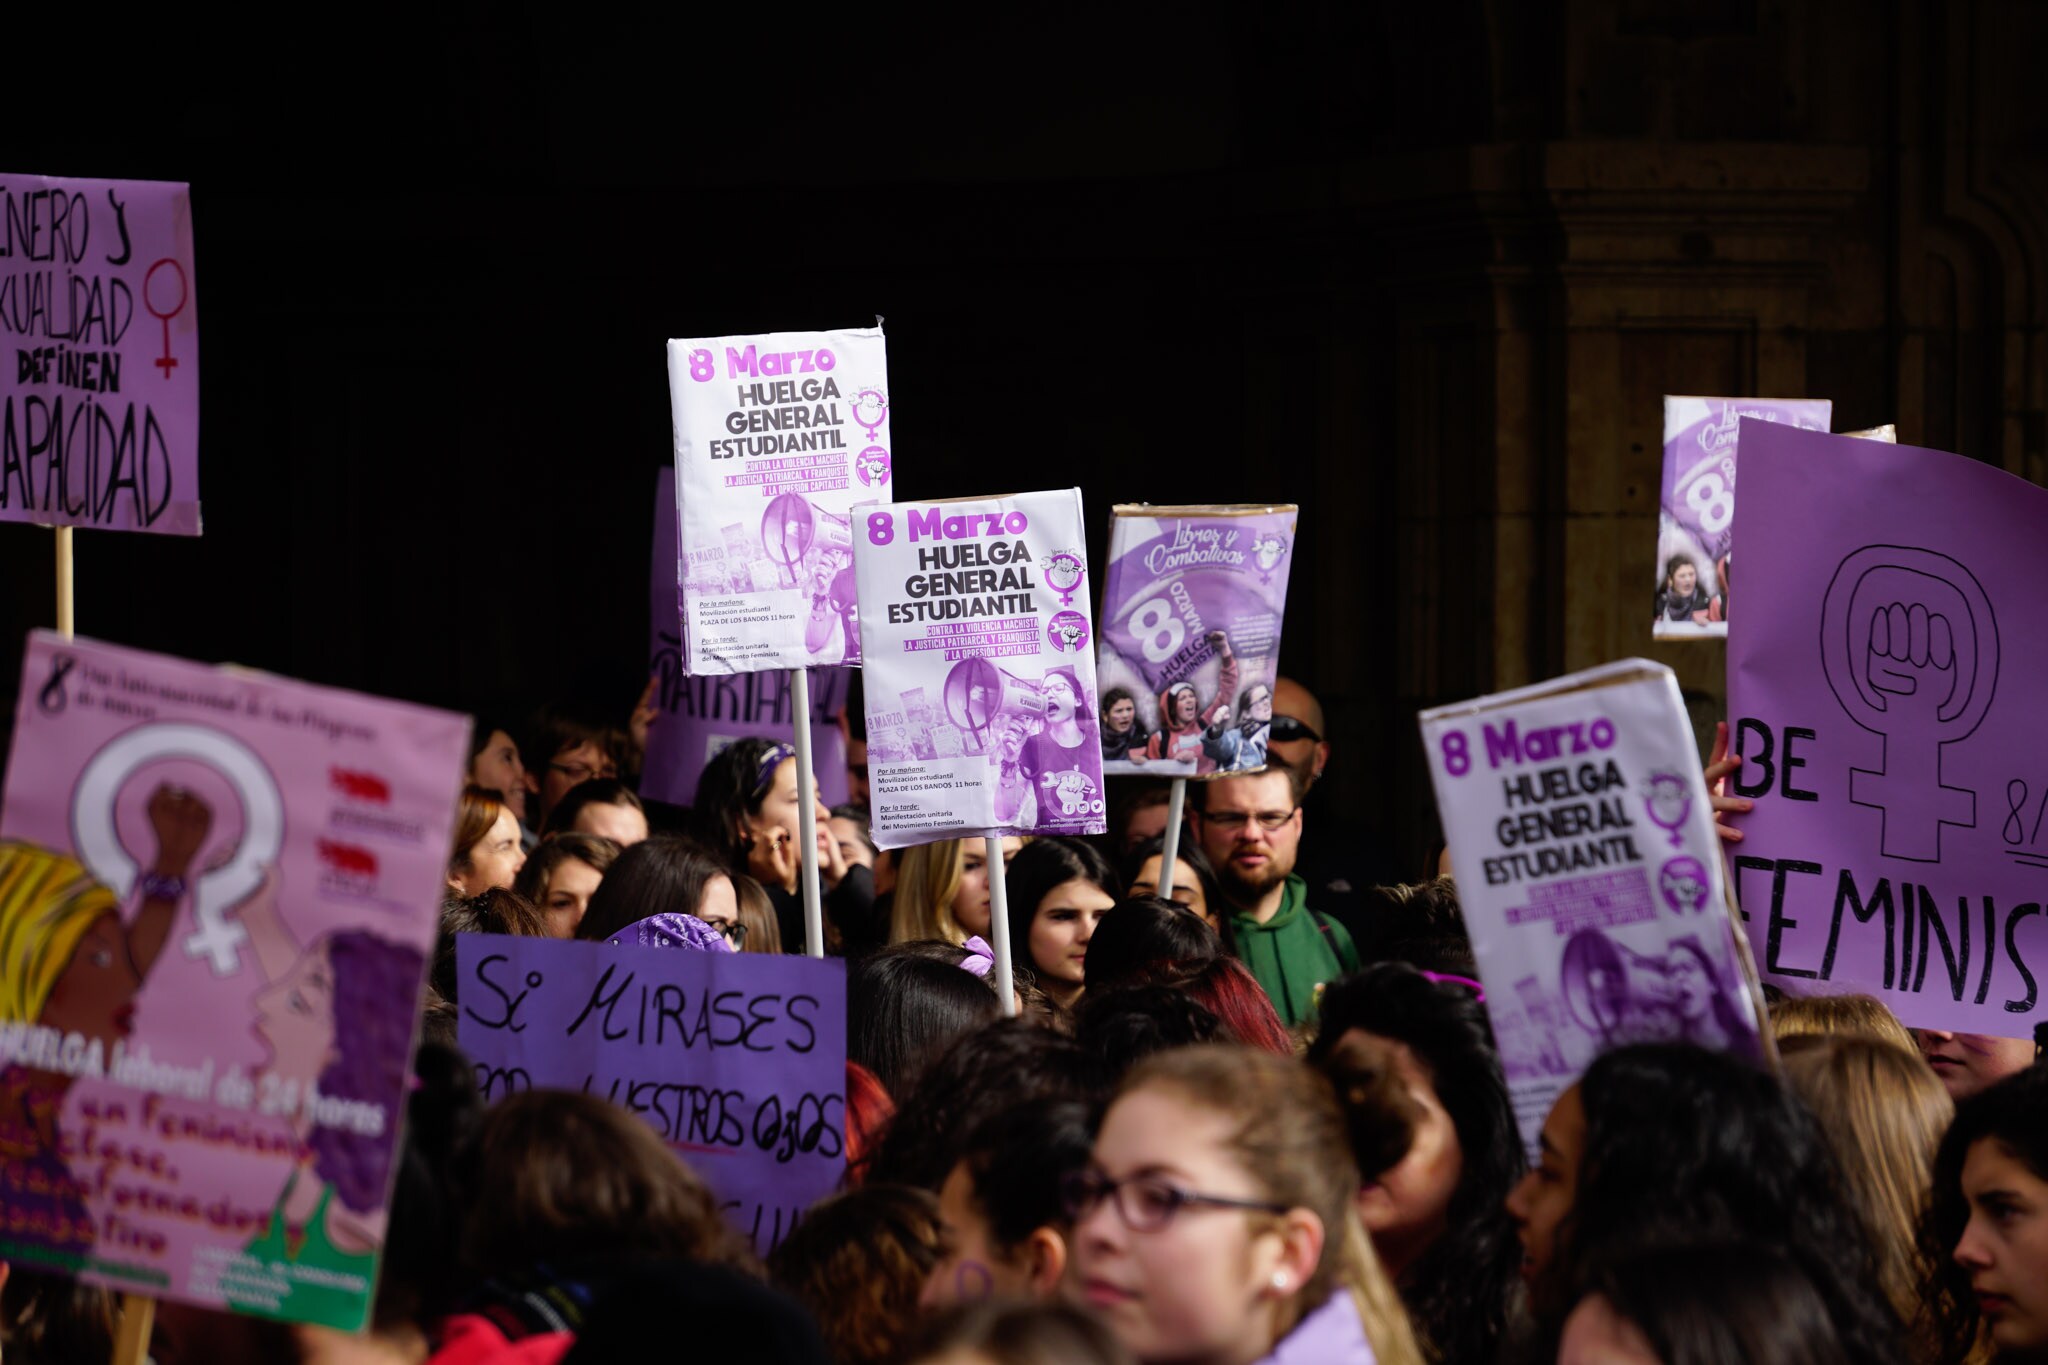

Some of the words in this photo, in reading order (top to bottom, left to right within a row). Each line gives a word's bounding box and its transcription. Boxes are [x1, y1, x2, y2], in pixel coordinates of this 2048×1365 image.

[688, 348, 715, 382] 8
[725, 344, 836, 379] Marzo
[737, 377, 841, 407] HUELGA
[725, 403, 844, 434] GENERAL
[709, 429, 847, 460] ESTUDIANTIL
[725, 475, 733, 487] LA
[735, 472, 763, 486] JUSTICIA
[765, 469, 802, 484] PATRIARCAL
[810, 465, 848, 480] FRANQUISTA
[746, 458, 770, 473] CONTRA
[771, 458, 781, 470] LA
[782, 455, 814, 469] VIOLENCIA
[815, 453, 847, 466] MACHISTA
[769, 484, 779, 495] LA
[810, 478, 849, 492] CAPITALISTA
[1686, 472, 1735, 533] 8
[867, 511, 894, 546] 8
[907, 507, 1028, 542] Marzo
[1166, 519, 1222, 553] Libres
[1226, 529, 1240, 547] y
[918, 540, 1032, 571] HUELGA
[1144, 543, 1246, 575] Combativas
[905, 566, 1035, 599] GENERAL
[699, 608, 738, 617] Movilización
[739, 605, 771, 614] estudiantil
[700, 617, 719, 626] PLAZA
[720, 617, 729, 625] DE
[730, 616, 742, 624] LOS
[743, 614, 769, 623] BANDOS
[779, 613, 795, 621] horas
[887, 593, 1037, 624] ESTUDIANTIL
[1170, 581, 1205, 635] MARZO
[904, 640, 913, 651] LA
[914, 638, 946, 650] JUSTICIA
[948, 634, 989, 648] PATRIARCAL
[998, 629, 1040, 644] FRANQUISTA
[927, 624, 953, 637] CONTRA
[955, 623, 965, 634] LA
[966, 620, 1002, 634] VIOLENCIA
[1004, 617, 1039, 630] MACHISTA
[1128, 598, 1185, 664] 8
[702, 644, 744, 653] Manifestación
[745, 642, 769, 650] unitaria
[702, 654, 711, 662] del
[751, 650, 779, 659] Feminista
[952, 649, 962, 660] LA
[963, 645, 996, 660] OPRESIÓN
[997, 643, 1040, 656] CAPITALISTA
[868, 718, 874, 730] 8
[874, 711, 904, 728] MARZO
[1441, 730, 1471, 777] 8
[1481, 718, 1616, 768] Marzo
[1733, 717, 1818, 801] BE
[878, 774, 918, 784] Movilización
[919, 772, 954, 781] estudiantil
[897, 765, 926, 774] mañana:
[1501, 758, 1626, 808] HUELGA
[878, 784, 899, 793] PLAZA
[900, 784, 909, 792] DE
[910, 783, 923, 791] LOS
[924, 782, 952, 790] BANDOS
[964, 779, 982, 788] horas
[881, 811, 926, 821] Manifestación
[927, 810, 953, 819] unitaria
[900, 803, 919, 811] tarde:
[881, 822, 891, 831] del
[892, 820, 932, 830] Movimiento
[934, 818, 964, 828] Feminista
[1496, 797, 1634, 849] GENERAL
[1483, 836, 1643, 885] ESTUDIANTIL
[1735, 856, 2048, 1013] FEMINIS
[465, 954, 543, 1033] Si
[567, 963, 820, 1053] MIRASES
